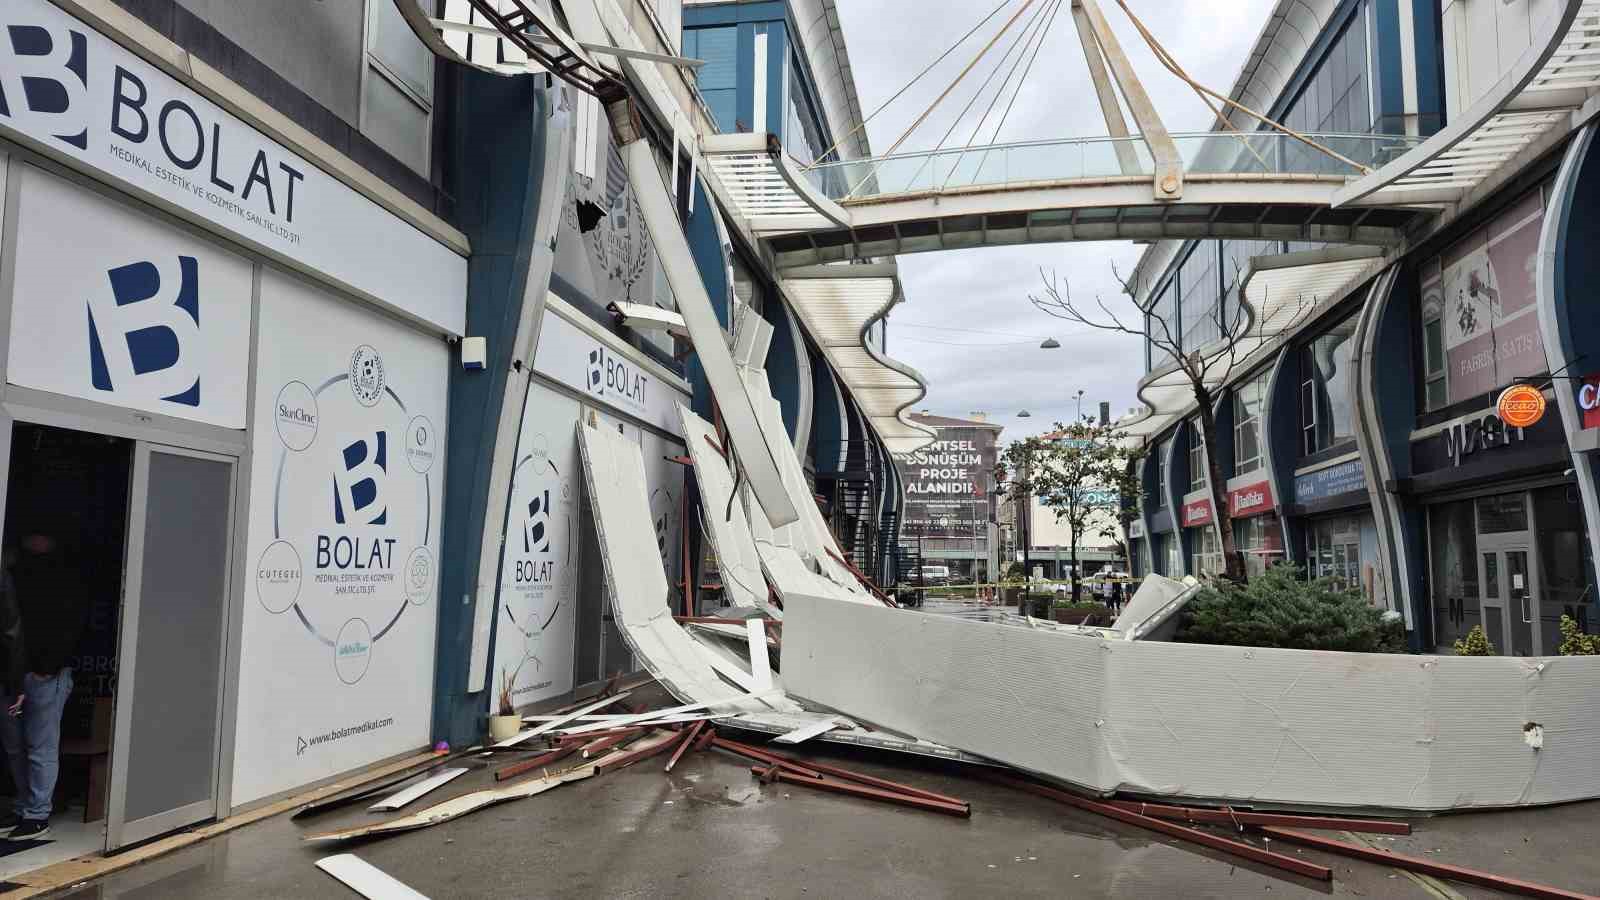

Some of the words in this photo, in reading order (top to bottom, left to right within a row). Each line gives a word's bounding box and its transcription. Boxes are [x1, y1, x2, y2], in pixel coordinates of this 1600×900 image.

[111, 65, 304, 223] BOLAT
[607, 357, 647, 407] BOLAT
[920, 468, 968, 480] PROJE
[316, 535, 396, 569] BOLAT
[516, 560, 554, 582] BOLAT
[308, 717, 394, 746] www.bolatmedikal.com
